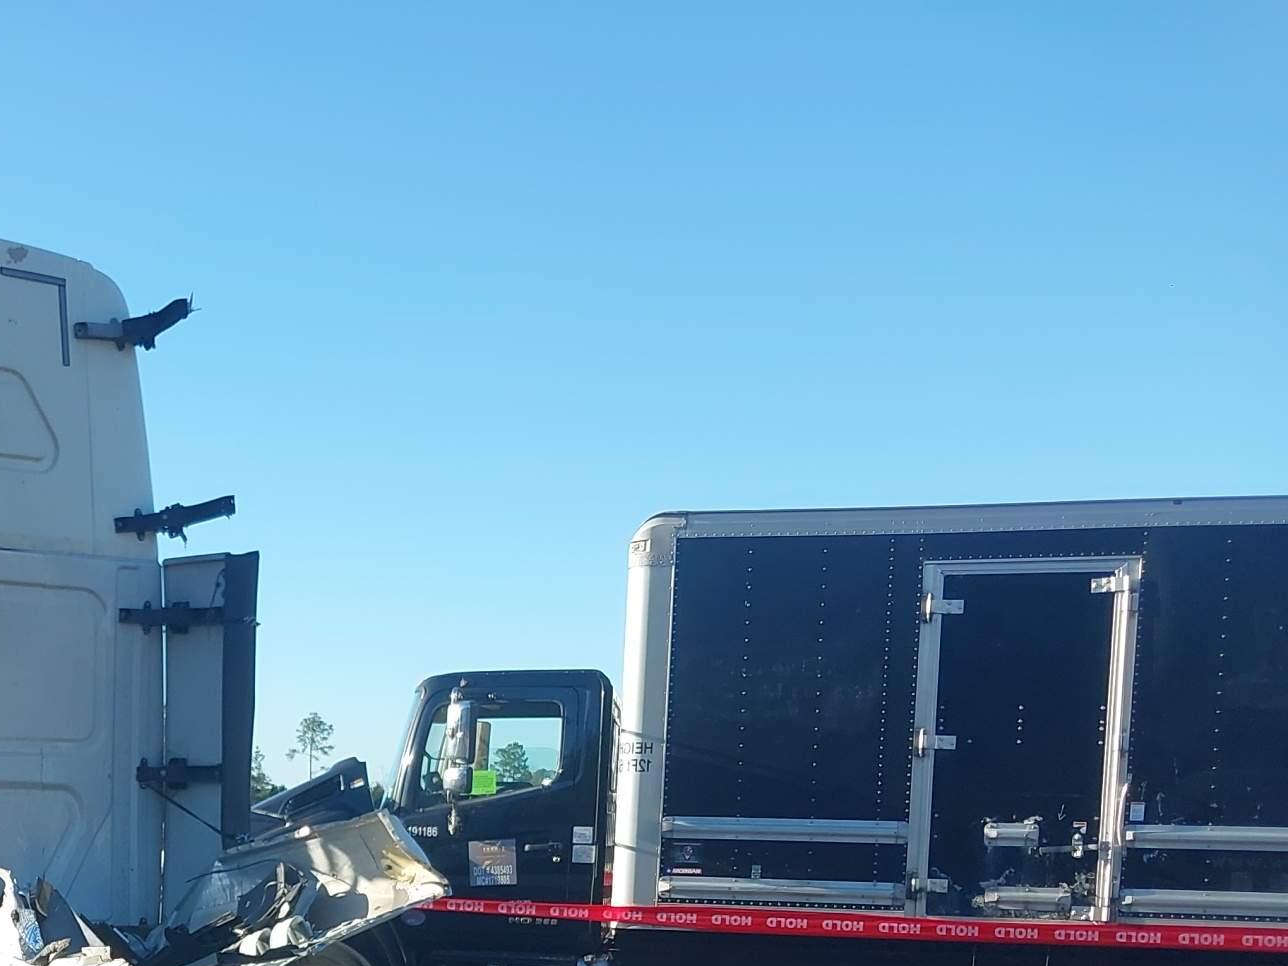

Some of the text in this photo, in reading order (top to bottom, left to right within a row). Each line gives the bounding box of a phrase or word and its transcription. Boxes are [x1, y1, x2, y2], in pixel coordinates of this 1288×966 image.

[447, 901, 1288, 948] HOLD HOLD HOLD HOLD HOLD HOLD HOLD HOLD HOLD HOLD HOLD HOLD HOLD HOLD HOLD
